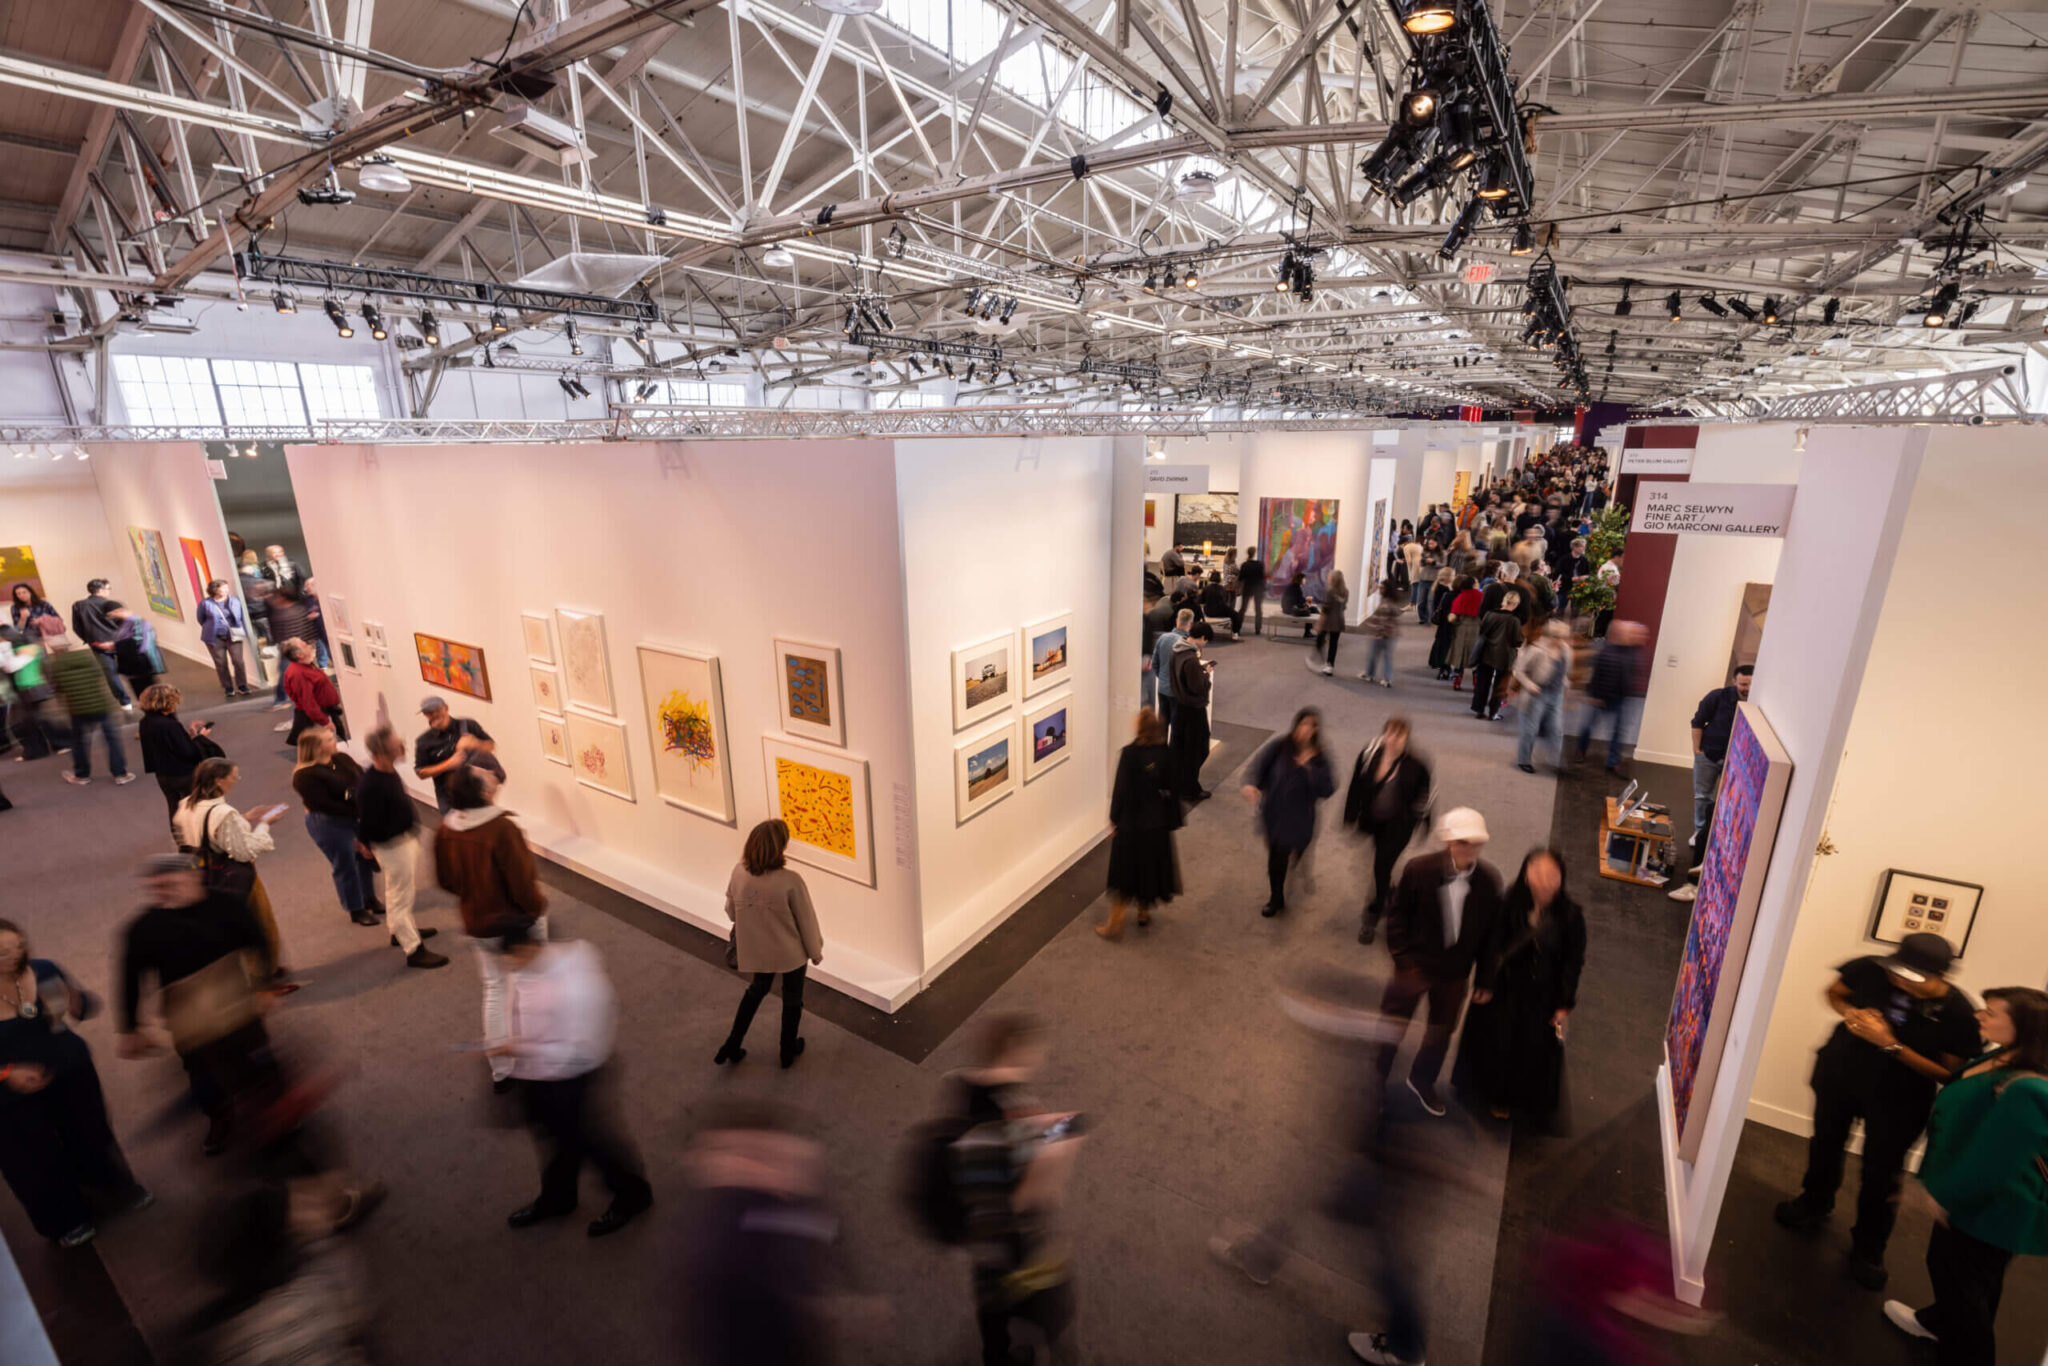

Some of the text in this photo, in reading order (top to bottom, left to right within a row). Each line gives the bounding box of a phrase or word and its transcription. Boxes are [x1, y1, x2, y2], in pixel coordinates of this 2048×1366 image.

[1469, 265, 1490, 281] EXIT
[1649, 492, 1668, 500] 314
[1647, 504, 1734, 514] MARC SELWYN
[1645, 513, 1706, 522] FINE ART /
[1644, 521, 1780, 534] GIO MARCONI GALLERY
